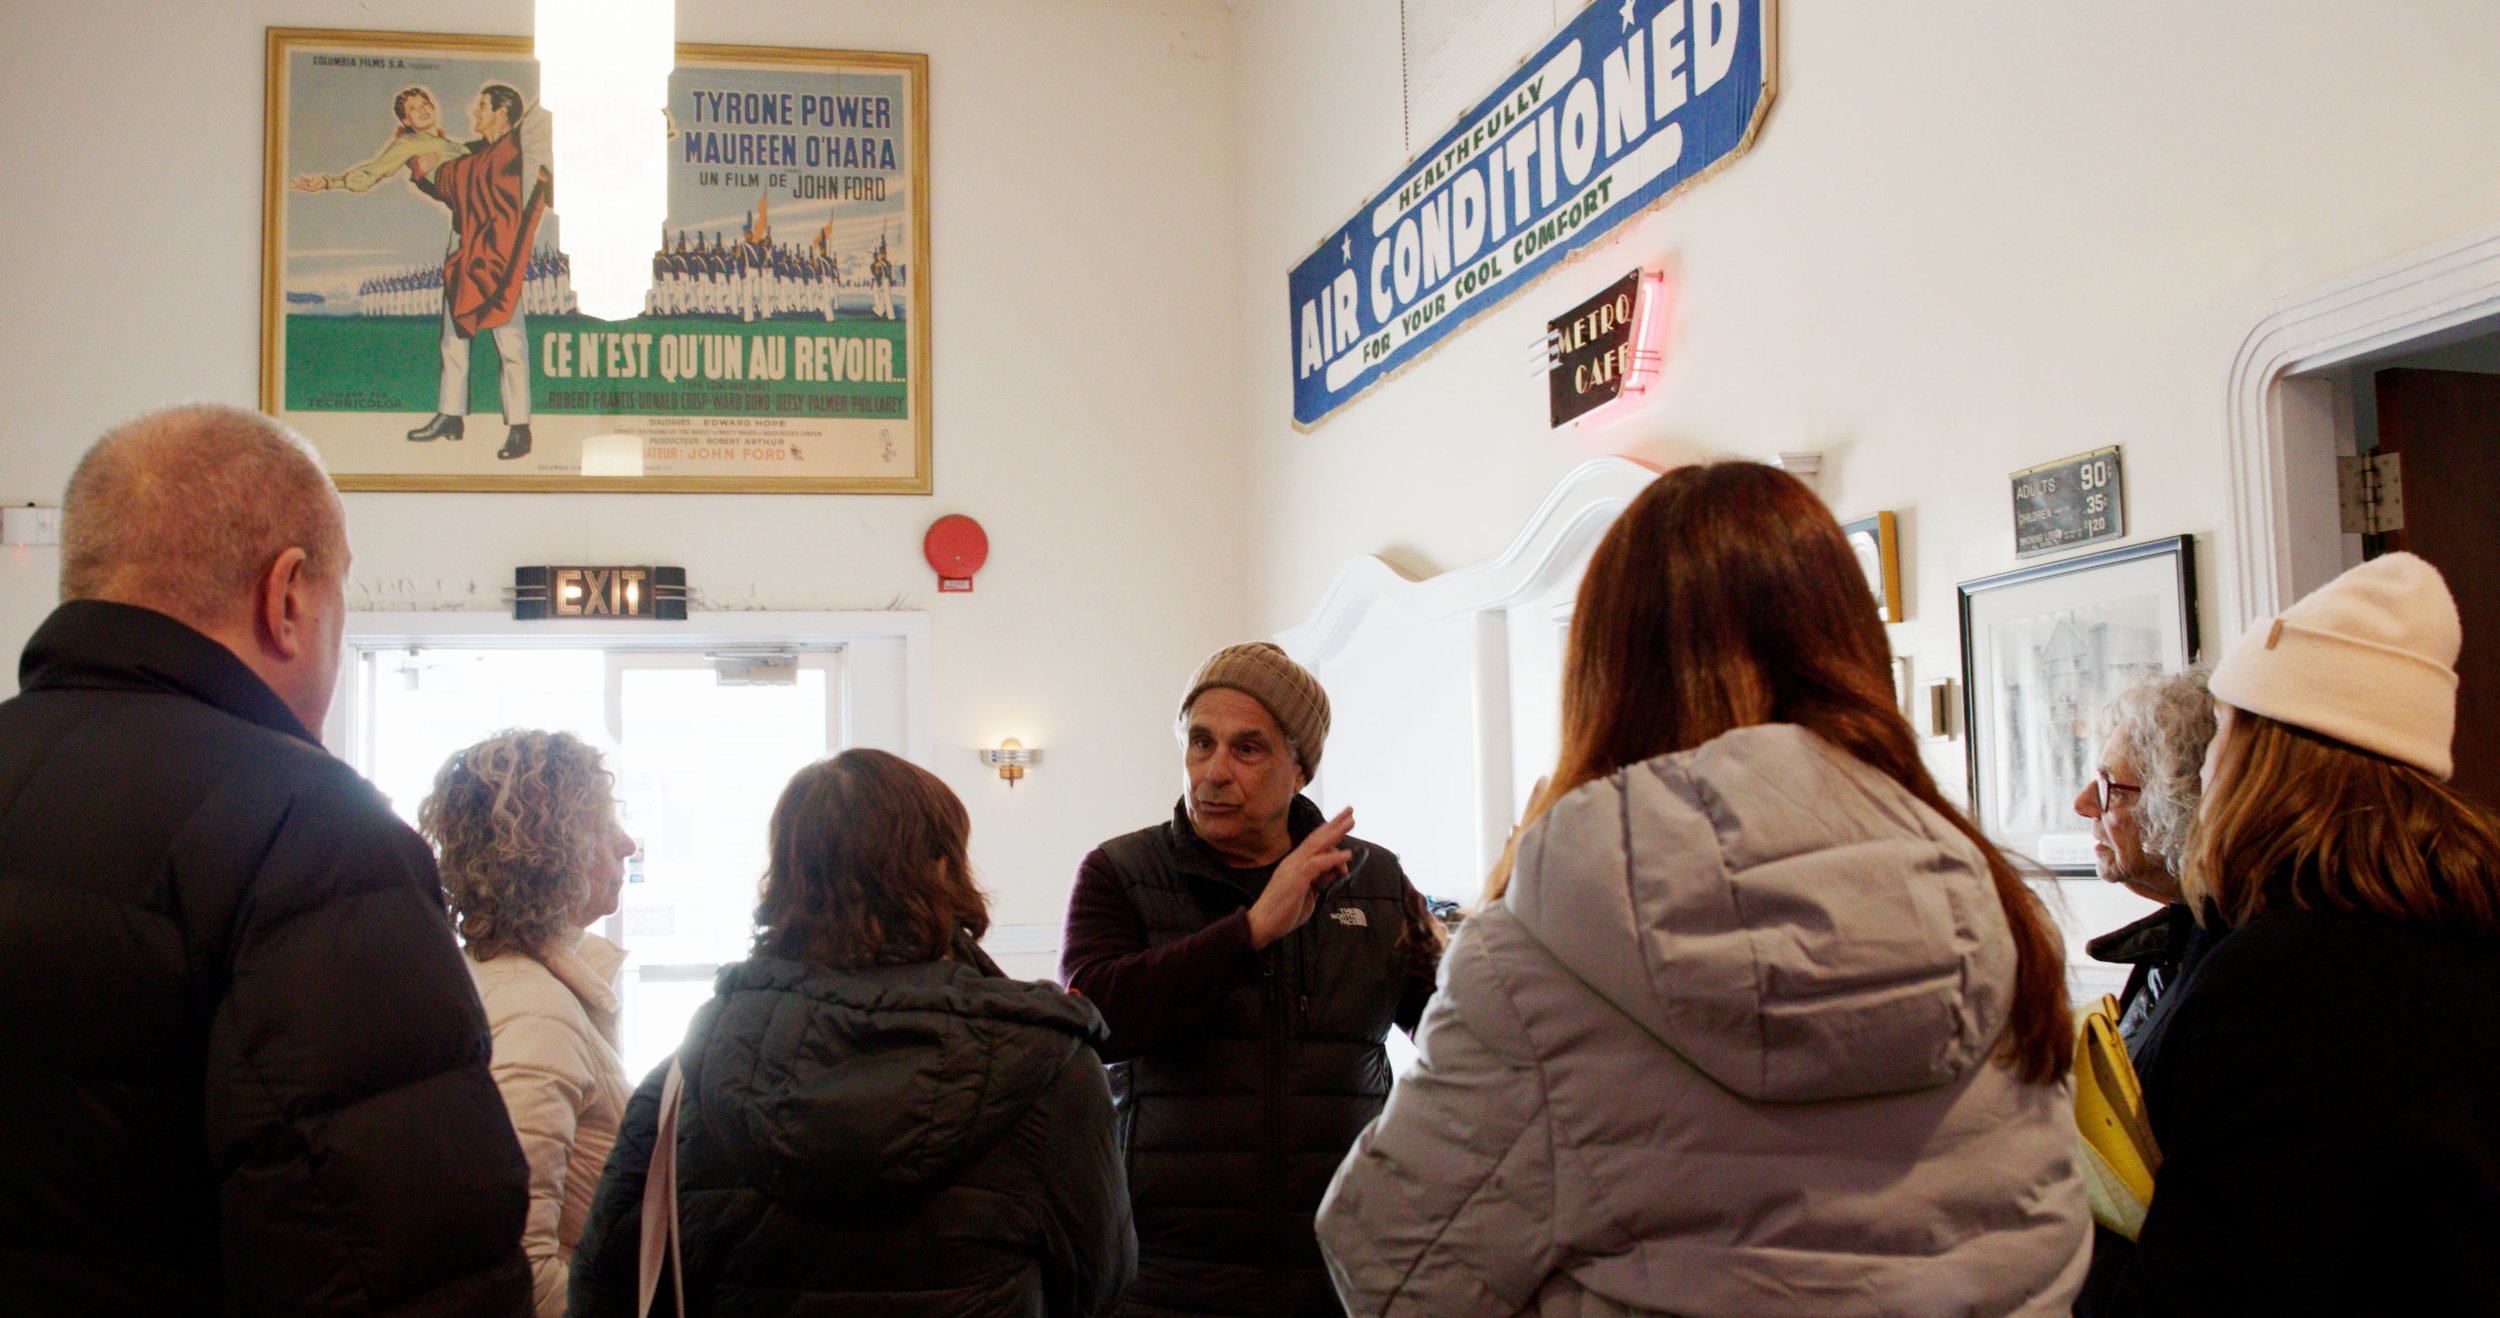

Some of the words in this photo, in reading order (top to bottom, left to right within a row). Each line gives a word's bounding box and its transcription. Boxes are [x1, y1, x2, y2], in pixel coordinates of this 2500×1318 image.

[313, 56, 356, 66] COLUMBIA
[360, 58, 385, 68] FILMS
[693, 91, 793, 125] TYRONE
[802, 95, 891, 129] POWER
[685, 132, 797, 166] MAUREEN
[806, 136, 896, 170] O'HARA
[1399, 76, 1545, 212] HEALTHFULLY
[700, 172, 719, 186] UN
[725, 173, 760, 188] FILM
[769, 174, 787, 188] DE
[793, 175, 838, 200] JOHN
[844, 177, 886, 202] FORD
[1301, 268, 1361, 379] AIR
[1371, 0, 1740, 324] CONDITIONED
[1363, 333, 1391, 363] FOR
[1402, 294, 1446, 337] YOUR
[1455, 262, 1502, 301] COOL
[1514, 176, 1613, 266] COMFORT
[1557, 293, 1630, 354] METRO
[543, 332, 573, 378] CE
[579, 332, 653, 379] N'EST
[660, 334, 743, 383] QU'UN
[748, 335, 786, 381] AU
[795, 336, 907, 383] REVOIR...
[1575, 342, 1629, 394] CAFE
[307, 398, 403, 409] TECHNICOLOR
[549, 391, 590, 409] ROBERT
[704, 419, 751, 427] EDWARD
[688, 448, 736, 460] JOHN
[742, 448, 786, 461] FORD
[707, 438, 740, 446] ROBERT
[2017, 478, 2056, 500] ADULTS
[2018, 509, 2053, 524] CHILDREN
[557, 570, 646, 615] EXIT
